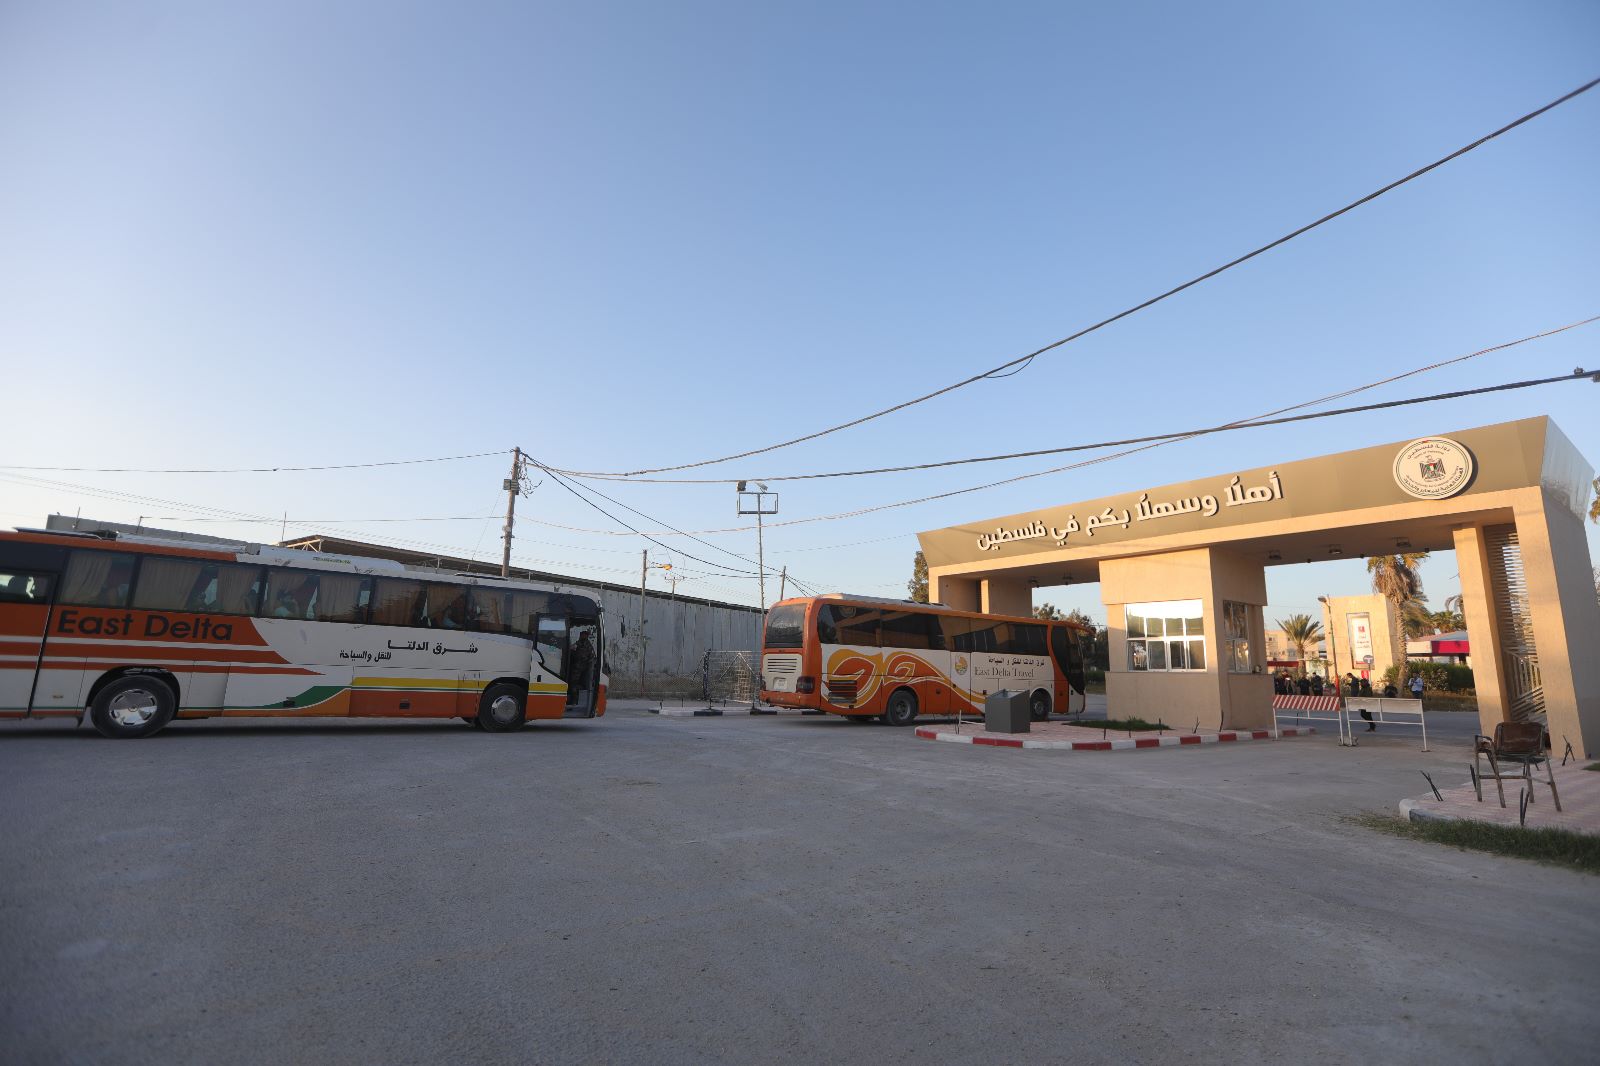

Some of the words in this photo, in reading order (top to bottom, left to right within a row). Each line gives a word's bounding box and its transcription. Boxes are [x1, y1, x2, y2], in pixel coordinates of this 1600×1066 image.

[1050, 514, 1080, 546] في
[1085, 507, 1131, 536] بكم
[976, 520, 1048, 551] فلسطين
[57, 609, 134, 636] East
[144, 614, 233, 641] Delta
[387, 640, 429, 651] الدلتا
[432, 642, 479, 656] شرق
[373, 651, 392, 662] للنقل
[974, 666, 990, 676] East
[992, 667, 1011, 677] Delta
[1012, 667, 1034, 678] Travel
